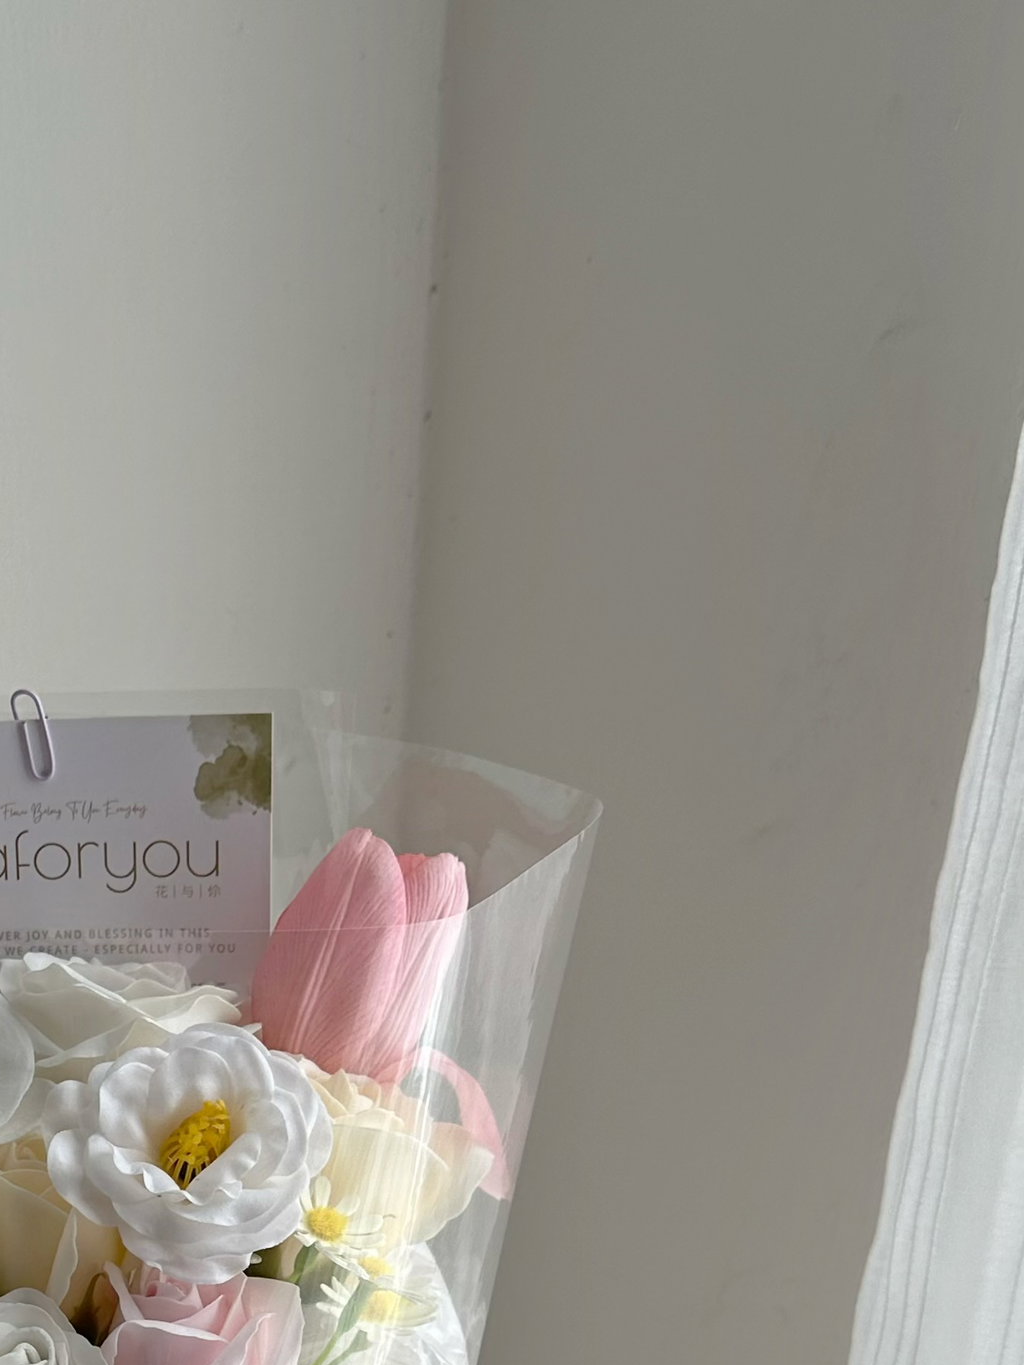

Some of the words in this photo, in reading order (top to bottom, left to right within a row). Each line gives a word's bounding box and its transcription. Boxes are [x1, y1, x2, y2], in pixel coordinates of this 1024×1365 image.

[26, 930, 49, 942] JOY
[54, 929, 82, 940] AND
[88, 928, 153, 940] BLESSING
[159, 927, 174, 939] IN
[180, 927, 211, 939] THIS
[4, 946, 23, 957] WE
[94, 943, 172, 955] ESPECIALLY
[178, 942, 202, 954] FOR
[209, 942, 237, 954] YOU
